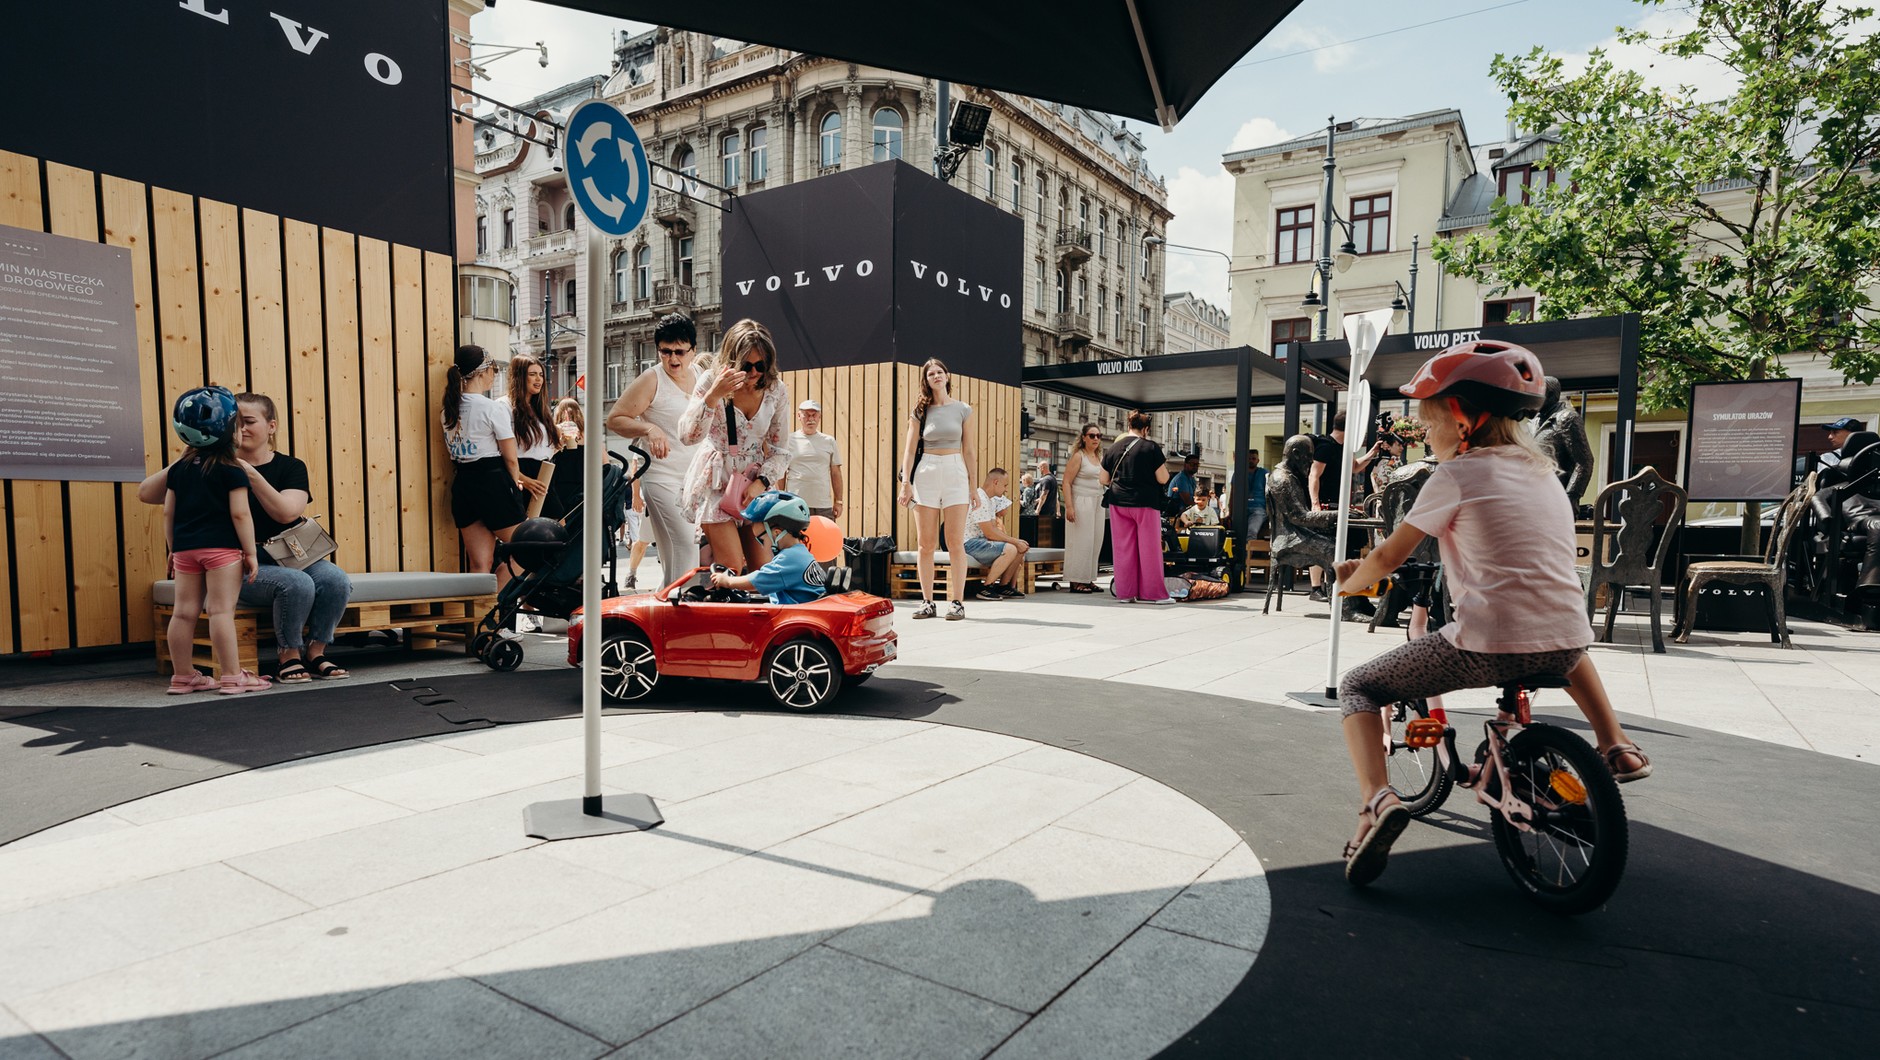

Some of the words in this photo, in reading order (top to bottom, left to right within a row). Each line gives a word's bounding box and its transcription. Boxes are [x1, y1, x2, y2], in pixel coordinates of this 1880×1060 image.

[4, 274, 94, 295] DROGOWEGO
[24, 267, 105, 287] MIASTECZKA
[736, 259, 874, 296] VOLVO
[910, 260, 1011, 309] VOLVO
[1414, 333, 1449, 350] VOLVO
[1452, 331, 1481, 346] PETS
[1097, 362, 1122, 375] VOLVO
[1124, 359, 1143, 373] KIDS
[1712, 412, 1746, 421] SYMULATOR
[1747, 411, 1774, 420] URAZÓW
[1698, 588, 1764, 596] VOLV
